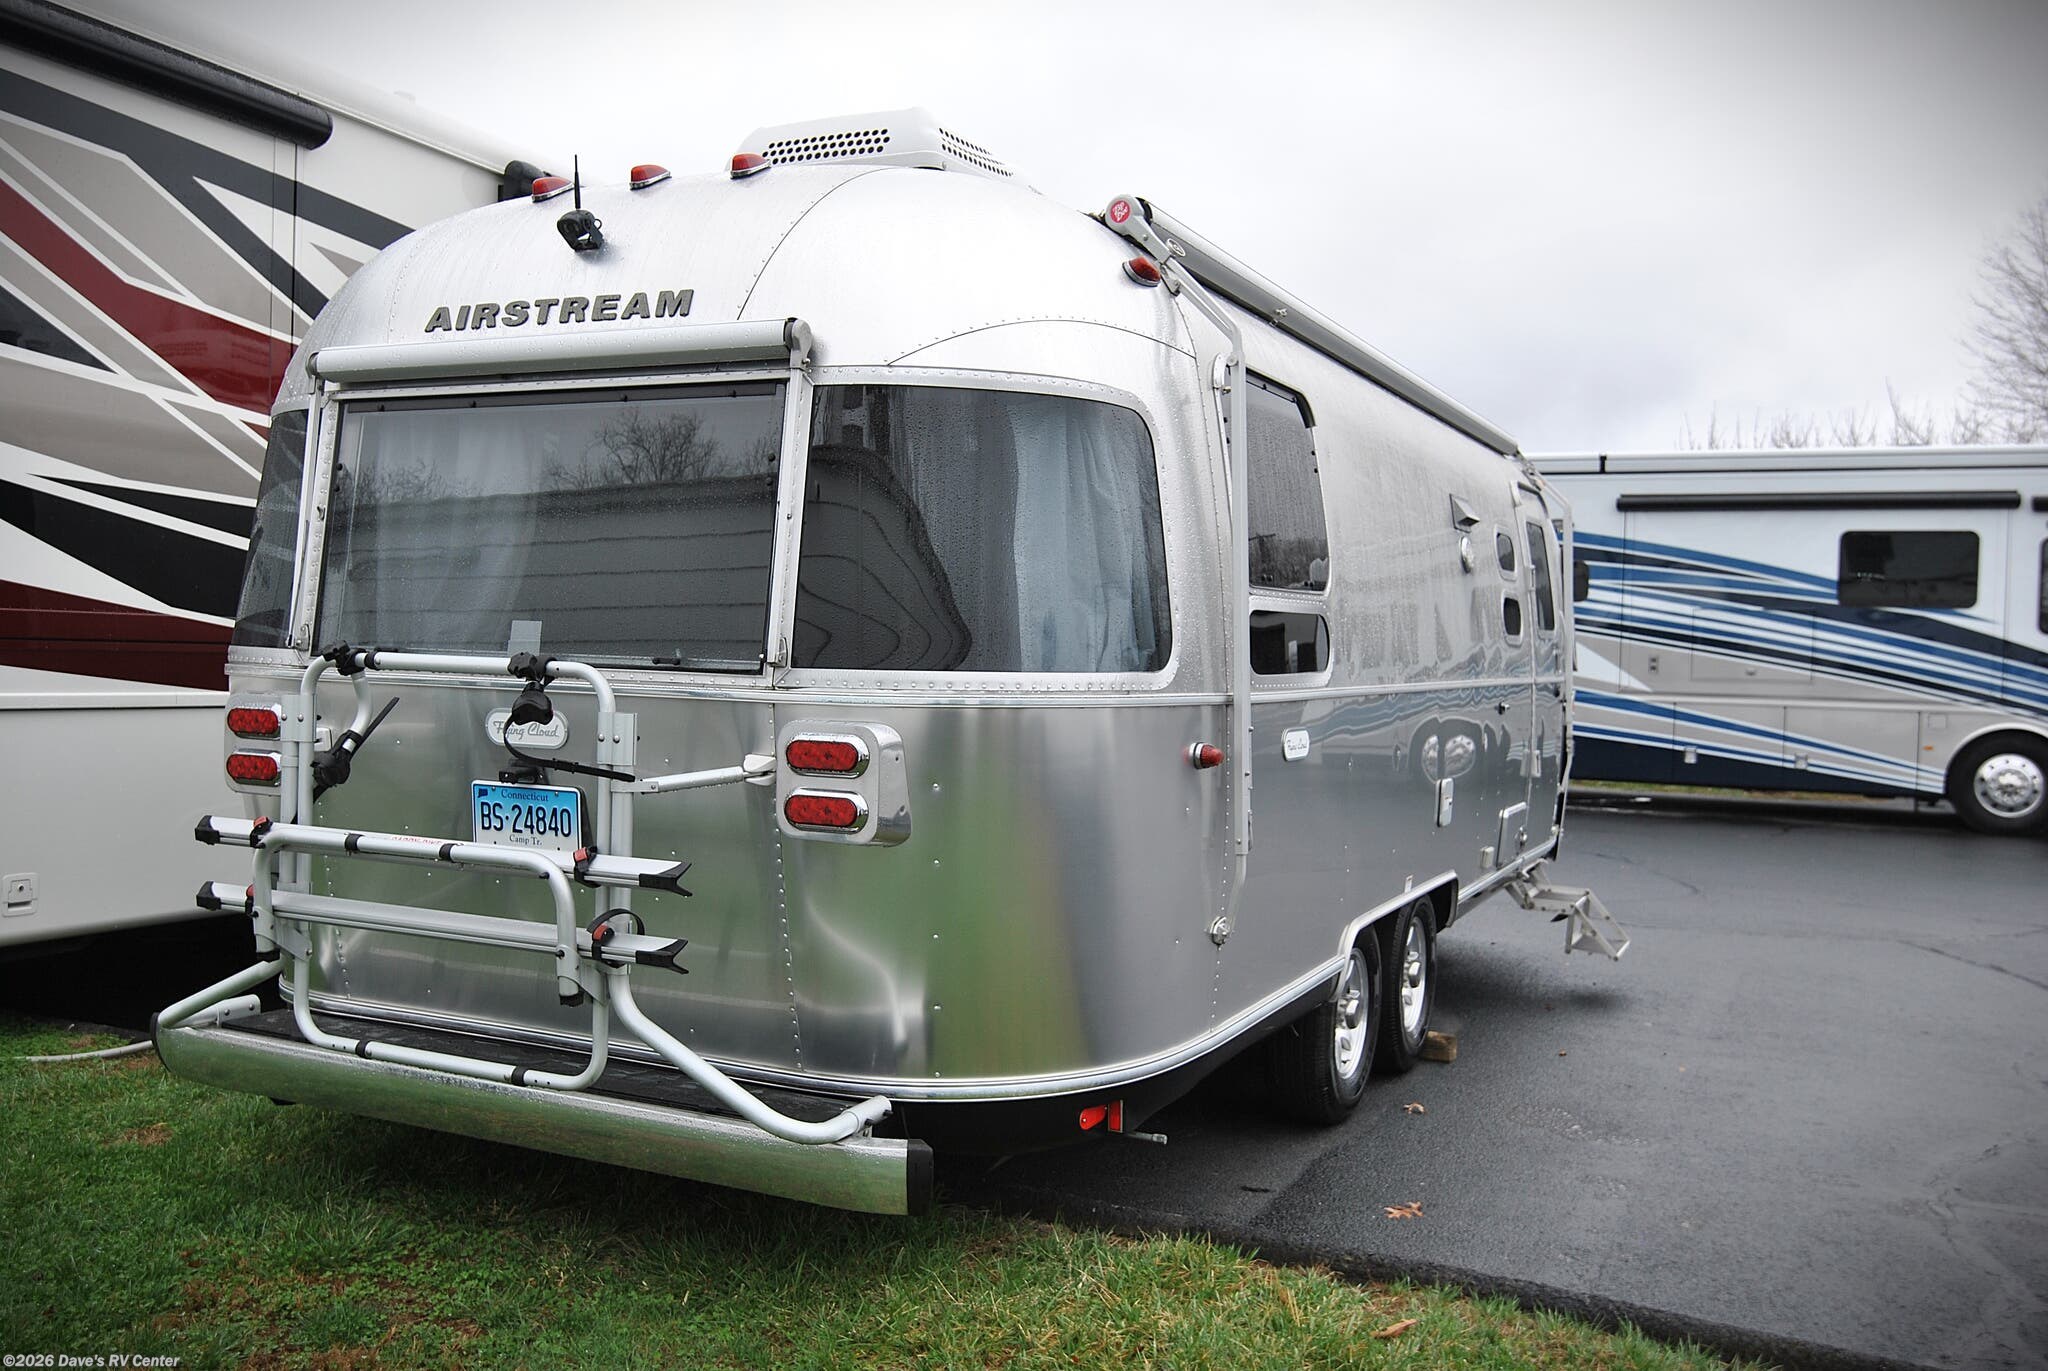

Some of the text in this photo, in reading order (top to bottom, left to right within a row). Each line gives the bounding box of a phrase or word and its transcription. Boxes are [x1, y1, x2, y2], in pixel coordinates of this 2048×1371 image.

[424, 289, 694, 333] AIRSTREAM
[493, 720, 560, 741] Fying Cloud
[501, 789, 549, 802] Connecticut
[509, 834, 530, 846] Camp
